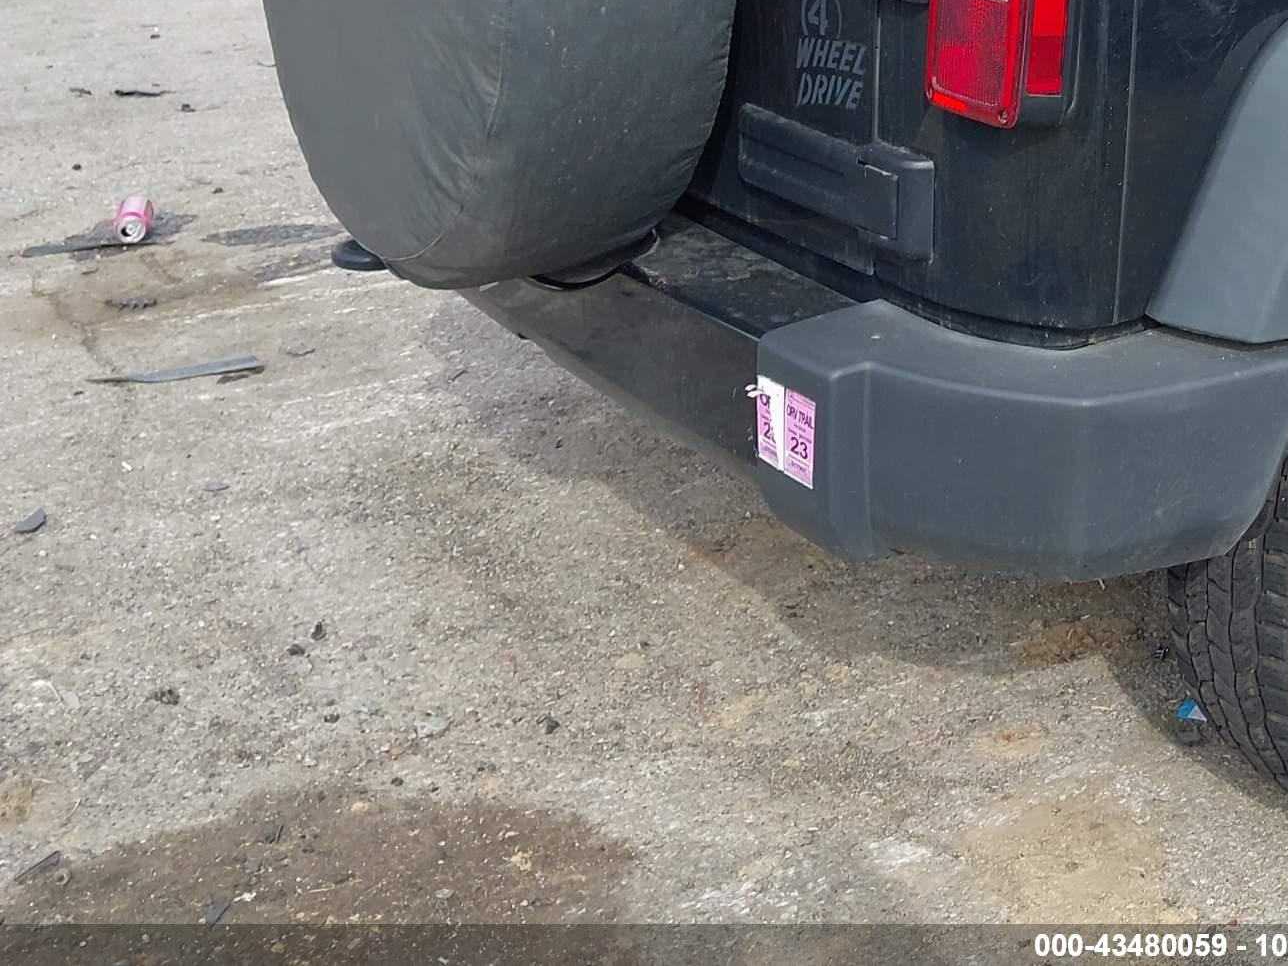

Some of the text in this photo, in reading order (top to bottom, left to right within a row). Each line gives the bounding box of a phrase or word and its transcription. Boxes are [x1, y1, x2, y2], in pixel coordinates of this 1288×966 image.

[796, 37, 868, 76] WHEEL
[796, 72, 864, 109] DRIVE
[790, 436, 808, 460] 23
